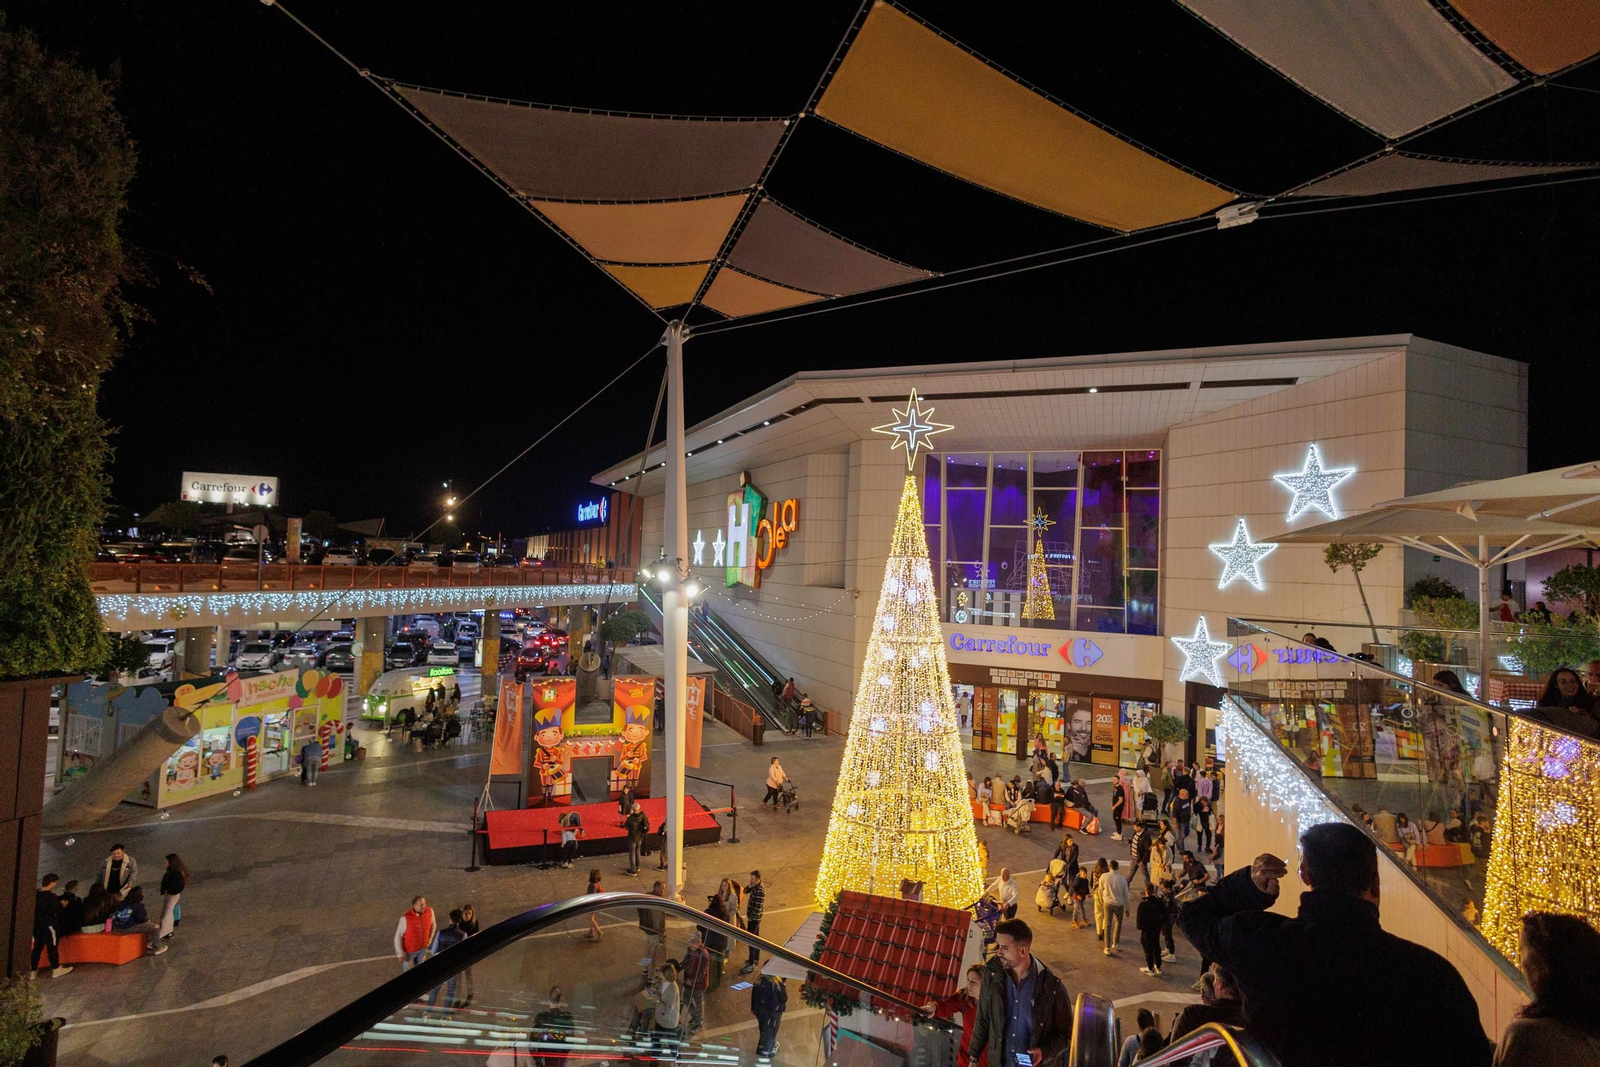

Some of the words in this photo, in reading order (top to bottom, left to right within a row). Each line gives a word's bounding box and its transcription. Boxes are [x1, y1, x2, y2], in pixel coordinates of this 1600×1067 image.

[191, 481, 247, 492] Carrefour
[950, 633, 1051, 656] Carrefour
[247, 674, 295, 695] hache
